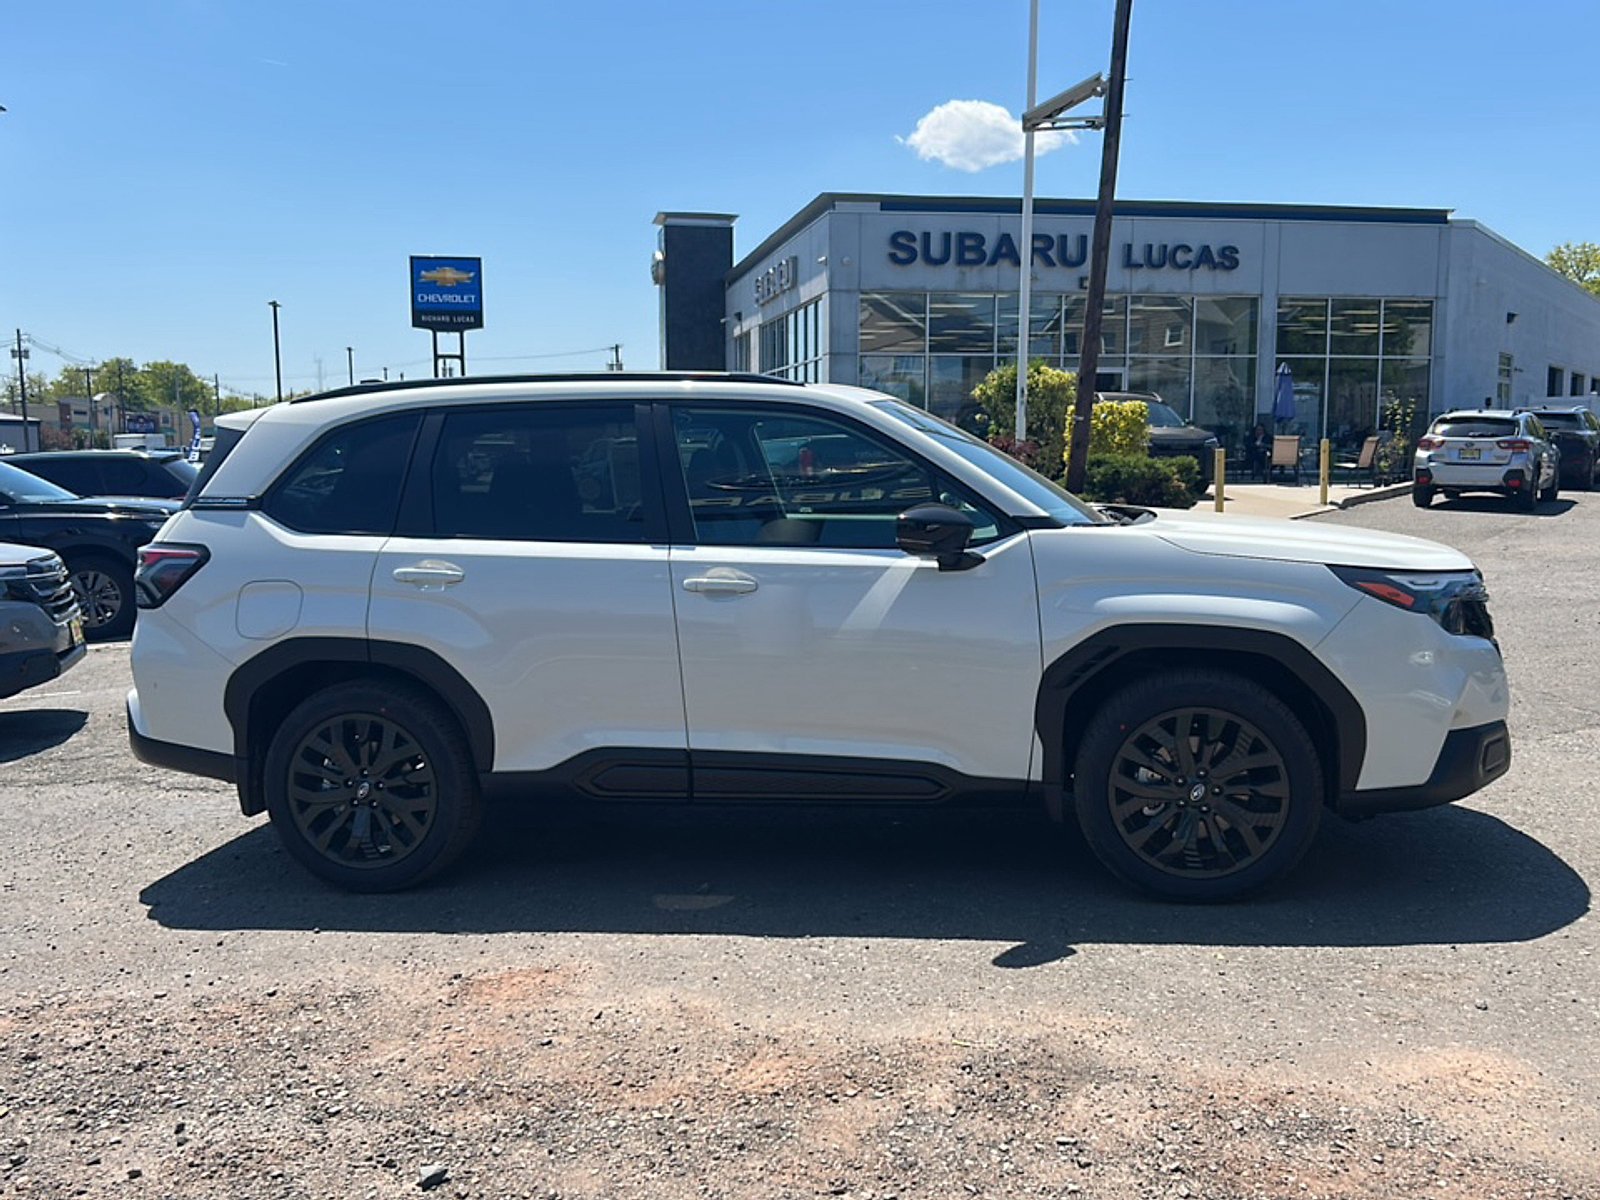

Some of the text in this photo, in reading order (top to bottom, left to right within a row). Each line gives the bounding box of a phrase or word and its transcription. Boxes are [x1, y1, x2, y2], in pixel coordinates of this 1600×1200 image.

[888, 230, 1240, 271] SUBARU LUCAS
[417, 293, 476, 304] CHEVROLET
